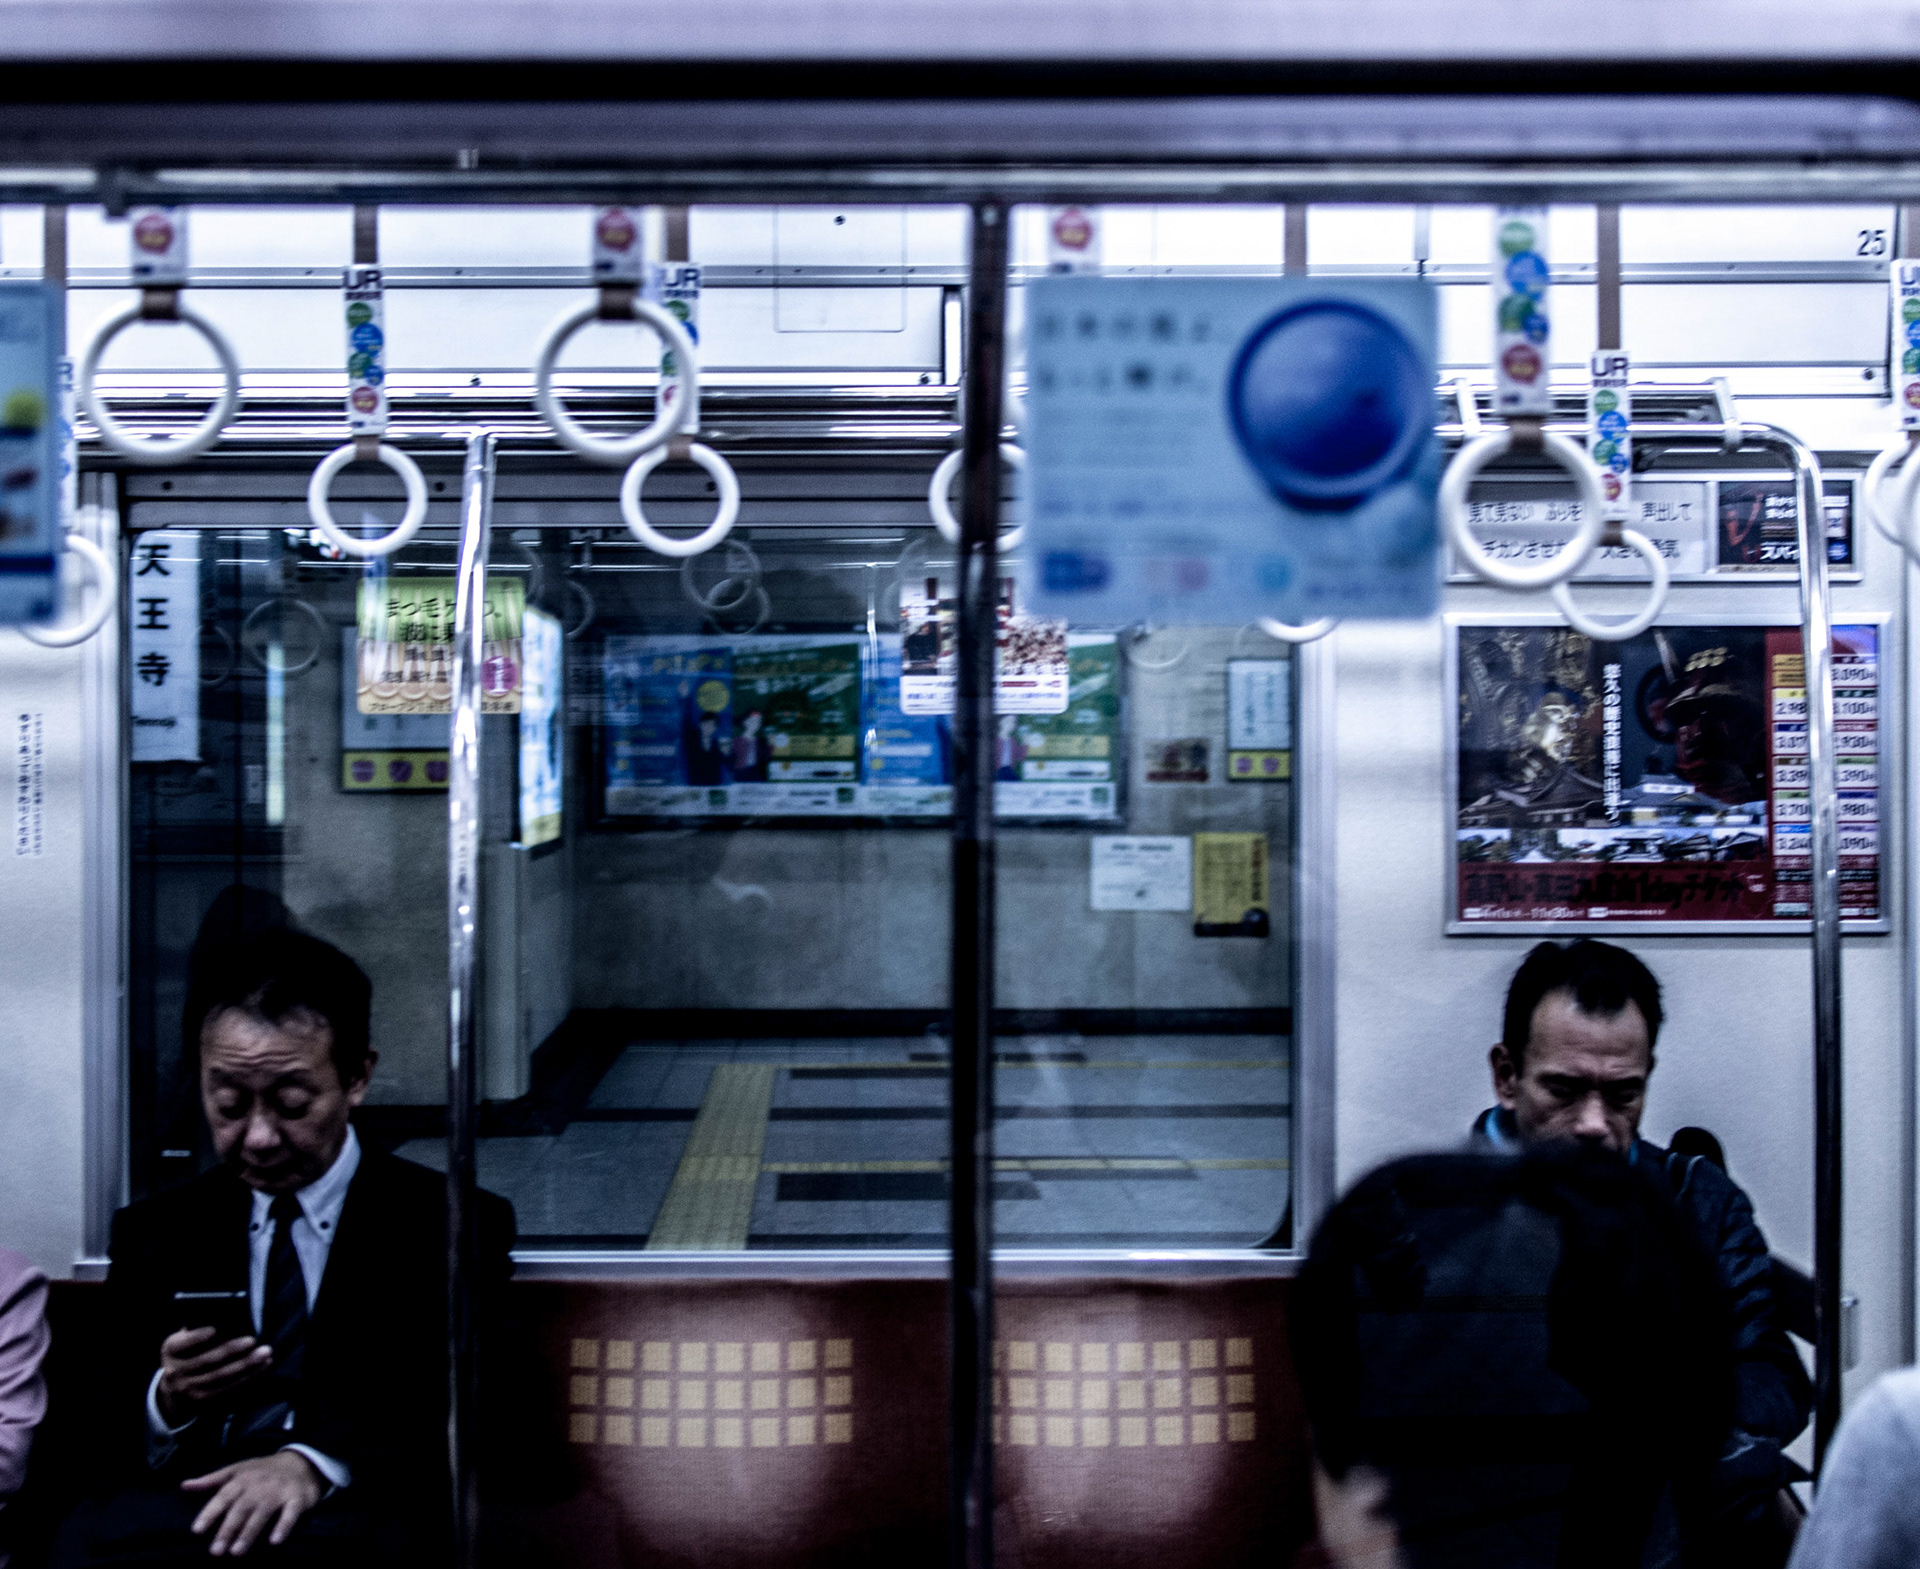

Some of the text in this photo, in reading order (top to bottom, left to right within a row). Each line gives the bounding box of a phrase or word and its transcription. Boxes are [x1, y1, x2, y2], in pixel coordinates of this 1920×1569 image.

[1857, 229, 1886, 256] 25
[344, 270, 382, 289] UR
[1592, 357, 1628, 377] UR
[1641, 502, 1692, 521] 声出して
[136, 543, 172, 686] 天王寺
